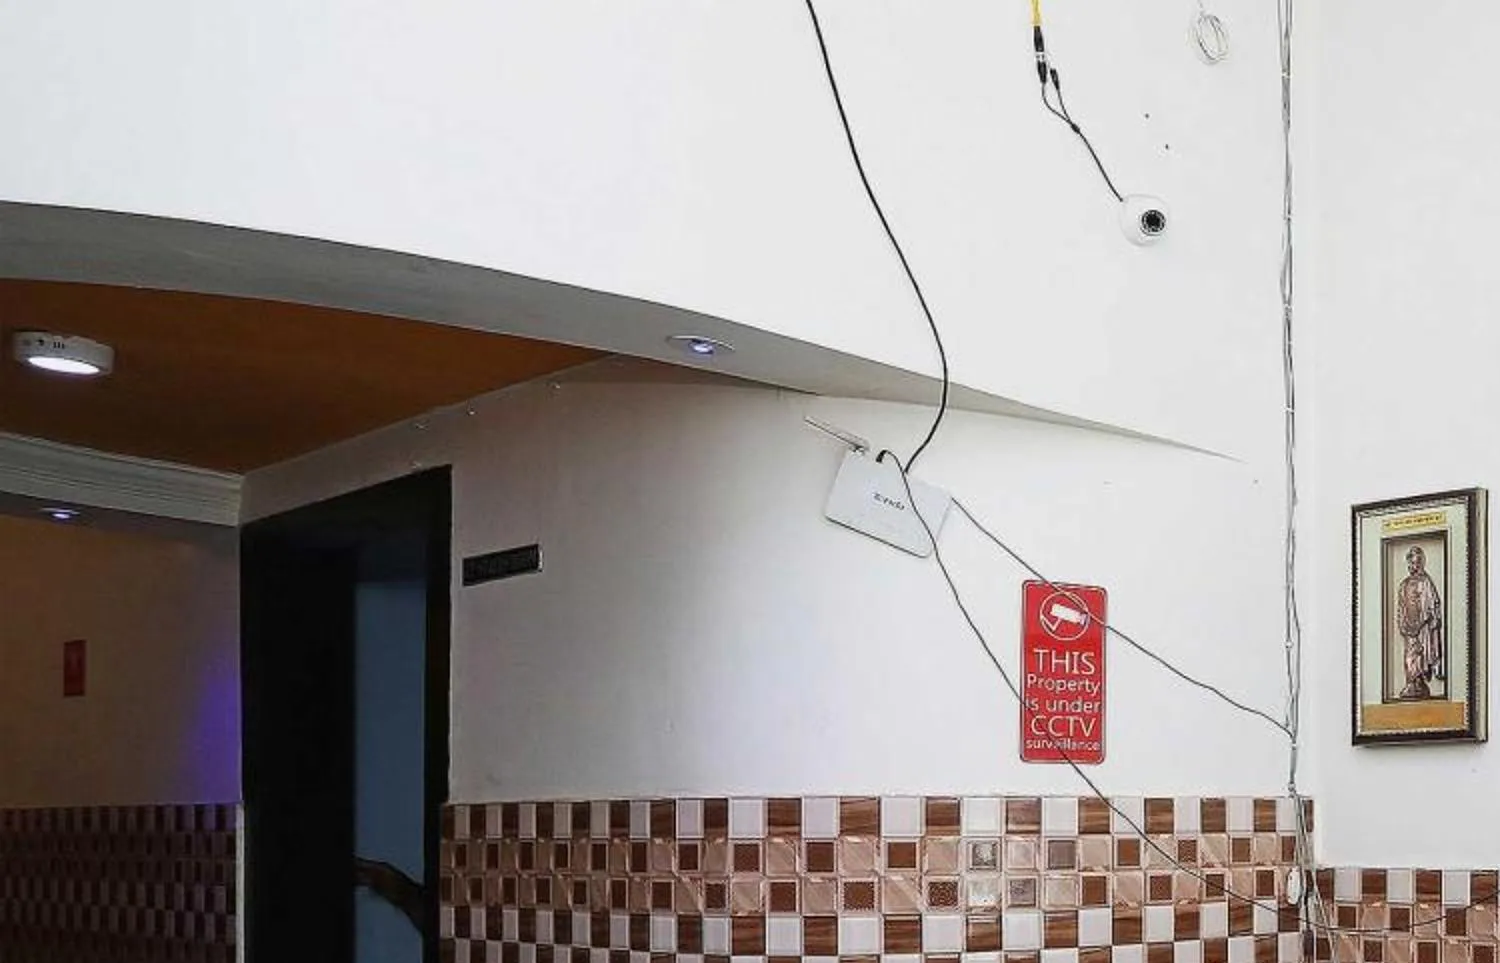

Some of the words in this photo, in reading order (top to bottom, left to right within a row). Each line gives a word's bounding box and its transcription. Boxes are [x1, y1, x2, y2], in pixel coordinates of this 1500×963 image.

[1033, 648, 1095, 675] THIS
[1027, 673, 1100, 697] Property
[1025, 694, 1039, 711] is
[1045, 696, 1101, 713] under
[1031, 715, 1096, 737] CCTV
